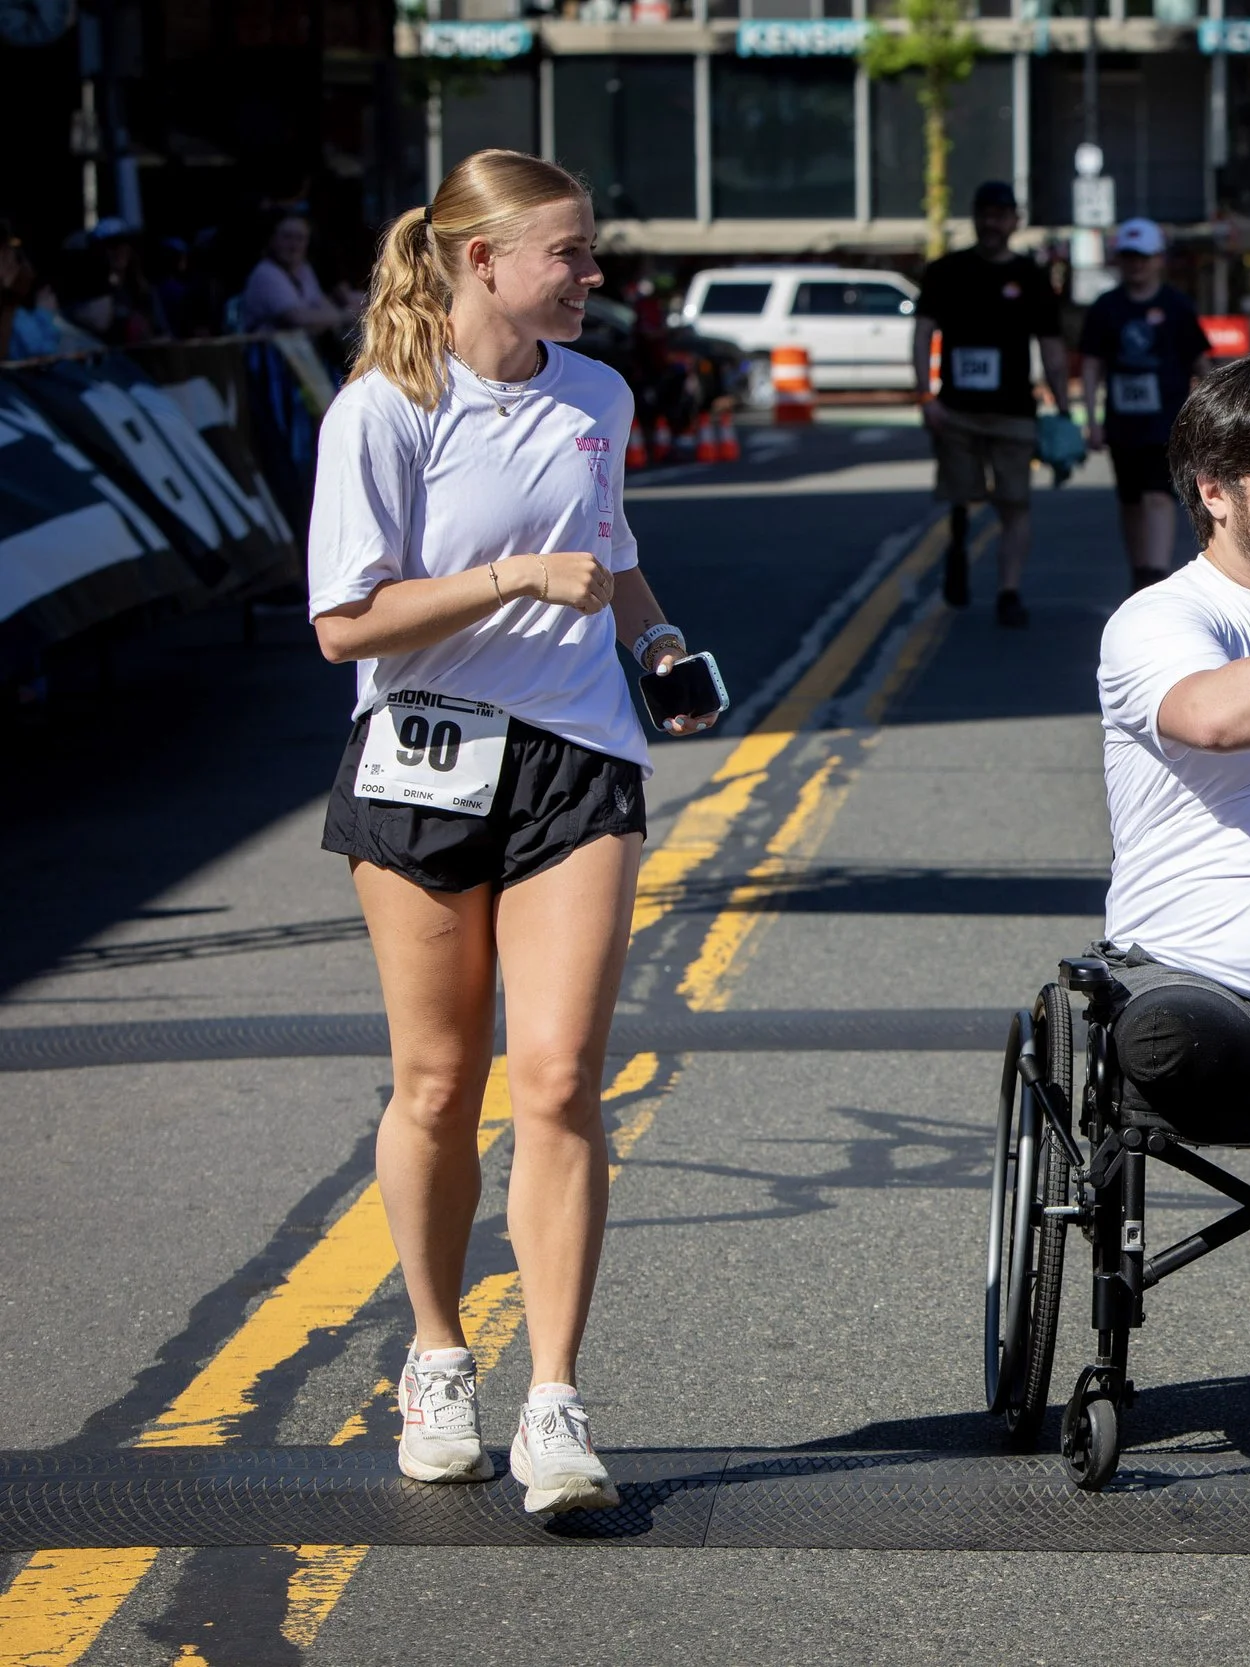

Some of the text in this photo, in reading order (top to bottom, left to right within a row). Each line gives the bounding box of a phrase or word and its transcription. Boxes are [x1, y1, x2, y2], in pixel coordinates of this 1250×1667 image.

[387, 690, 477, 714] BIONIC
[474, 708, 494, 718] 1Mi
[396, 715, 462, 772] 90
[361, 784, 484, 810] FOOD DRINK DRINK
